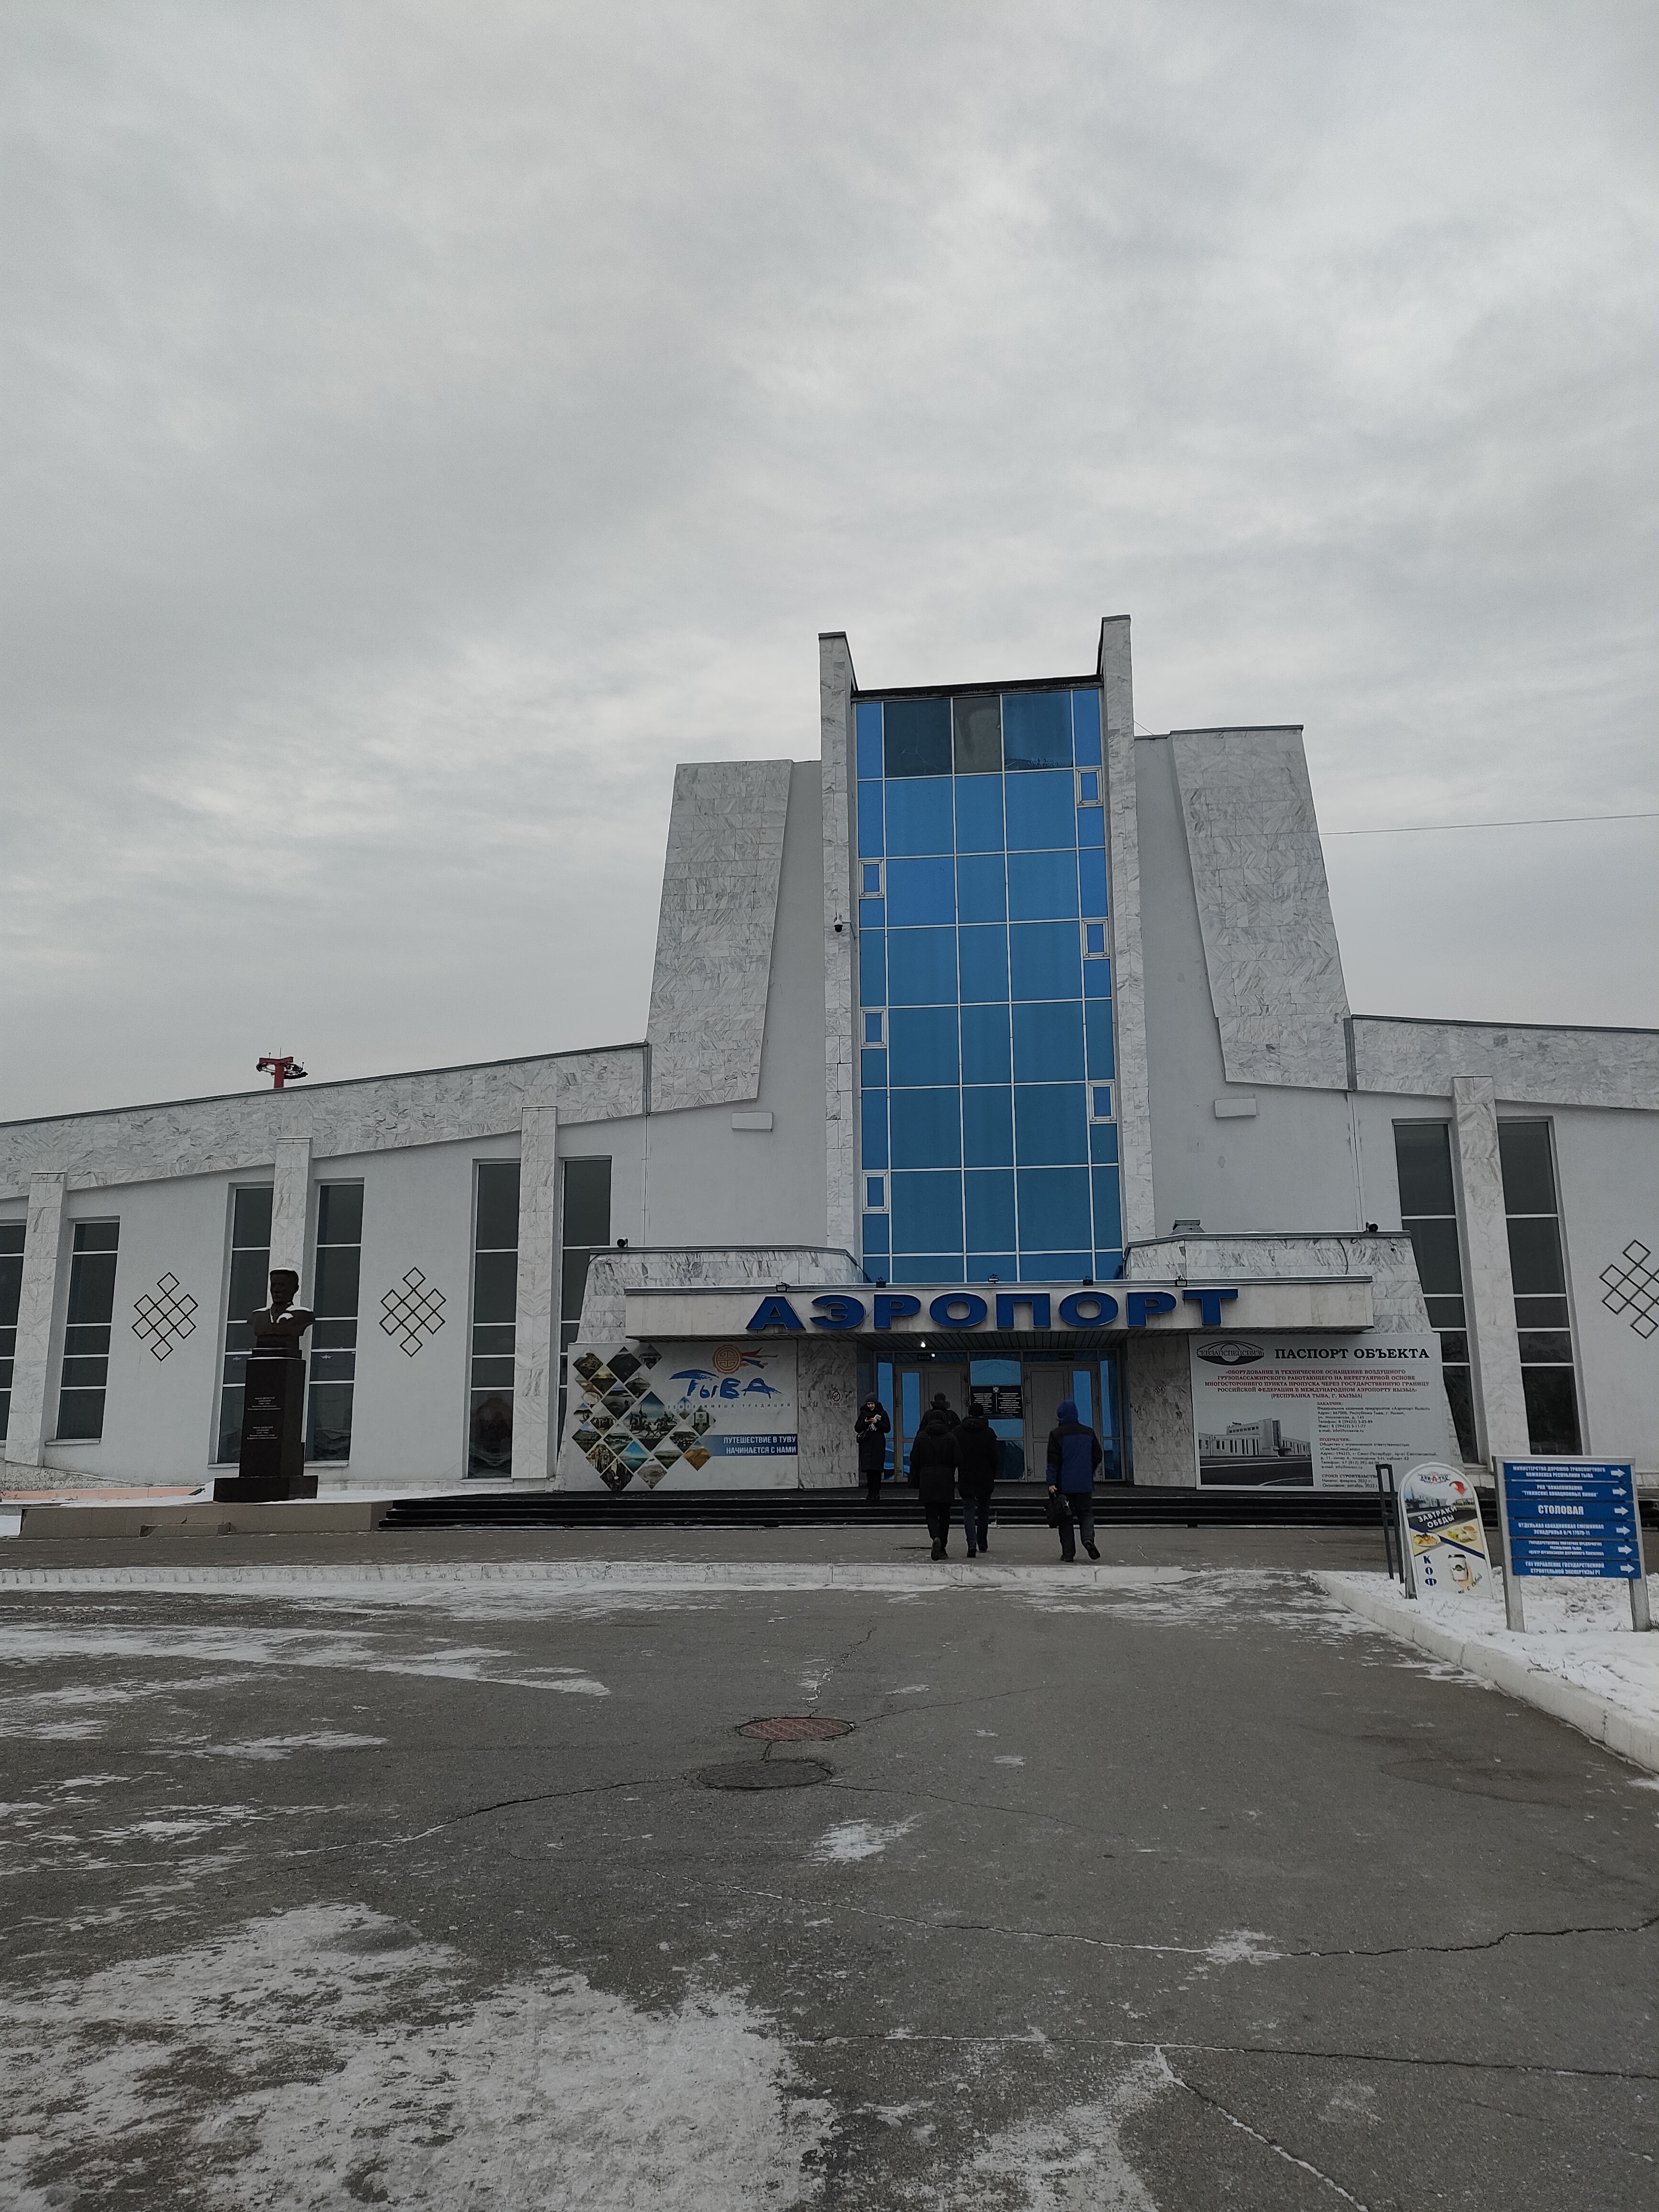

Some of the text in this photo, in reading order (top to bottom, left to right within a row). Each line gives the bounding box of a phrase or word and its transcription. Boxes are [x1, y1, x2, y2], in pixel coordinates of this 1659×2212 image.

[745, 1287, 1239, 1330] АЭРОПОРТ
[1275, 1348, 1430, 1360] ПАСПОРТ ОБЪЕКТА
[1417, 1505, 1458, 1523] ЗАВТРАКИ
[1537, 1504, 1584, 1515] СТОЛОВАЯ
[1427, 1515, 1455, 1528] ОБЕДЫ
